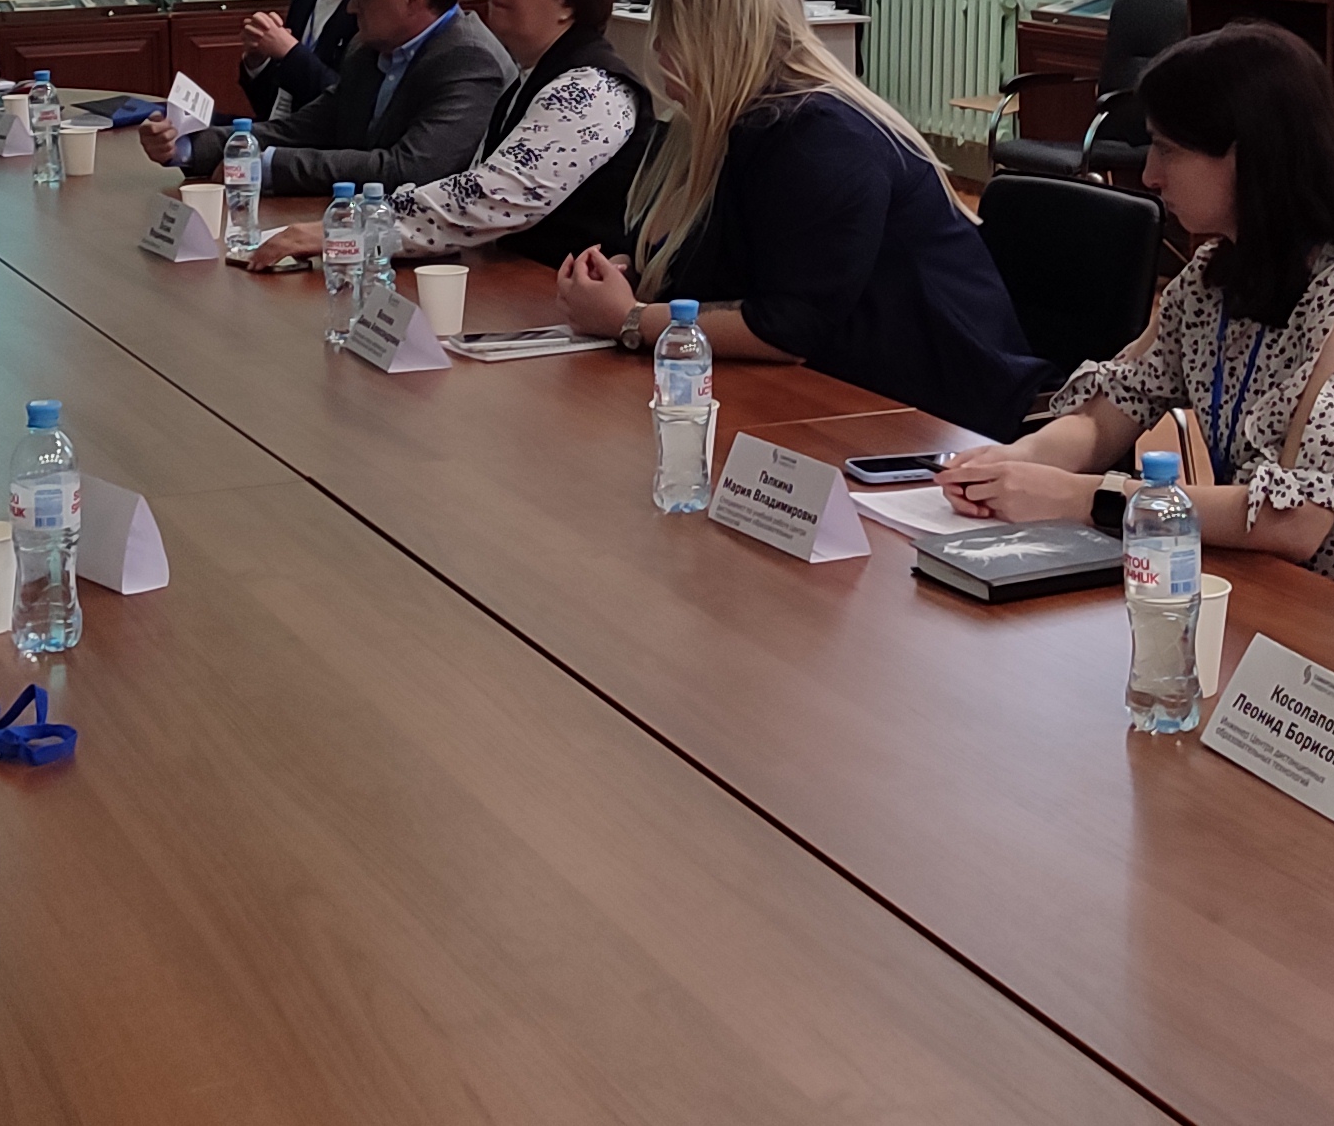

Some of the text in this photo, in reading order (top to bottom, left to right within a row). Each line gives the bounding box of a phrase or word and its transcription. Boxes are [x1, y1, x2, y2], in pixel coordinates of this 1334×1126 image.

[722, 476, 752, 498] Мария
[752, 488, 818, 525] Владимировна
[758, 469, 794, 494] Галкина
[1231, 692, 1284, 737] Леонид
